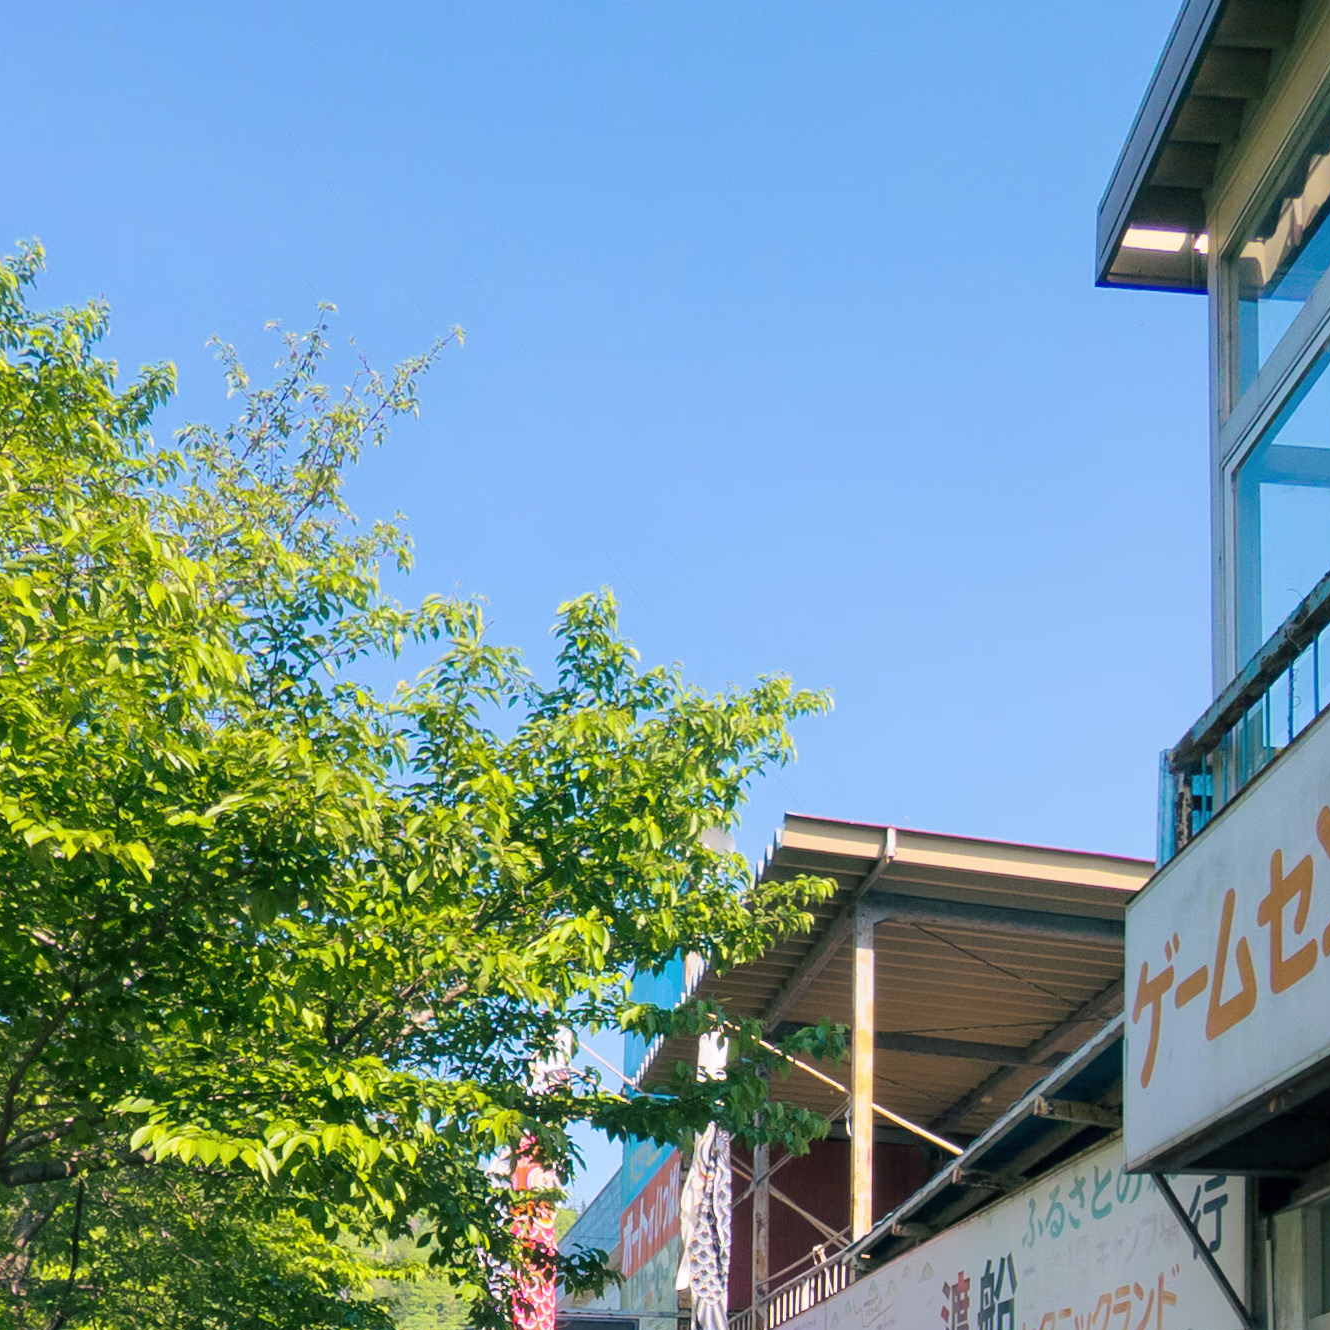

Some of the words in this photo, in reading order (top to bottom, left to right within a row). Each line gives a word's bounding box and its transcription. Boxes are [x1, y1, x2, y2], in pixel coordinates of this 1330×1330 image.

[1022, 1165, 1178, 1249] ふるさとの
